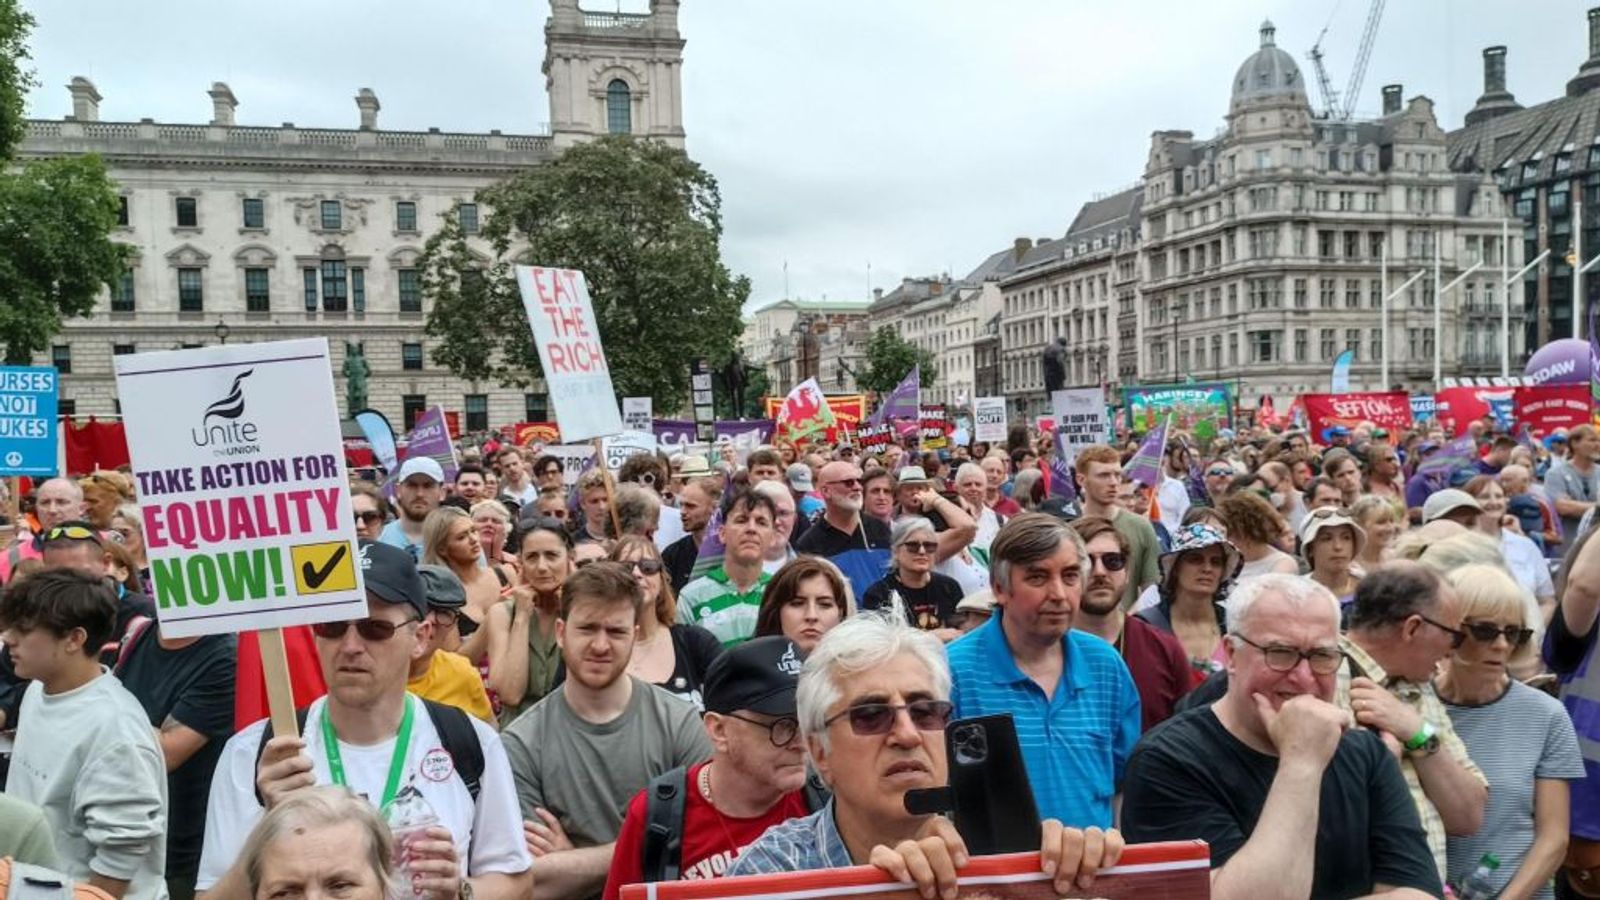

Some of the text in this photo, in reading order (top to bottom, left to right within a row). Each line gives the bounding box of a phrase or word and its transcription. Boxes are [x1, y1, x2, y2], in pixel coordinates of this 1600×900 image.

[532, 268, 579, 304] EAT
[544, 306, 589, 338] THE
[547, 341, 605, 373] RICH
[1532, 360, 1575, 384] SDAW
[1334, 399, 1392, 419] SEFTON
[136, 454, 338, 496] TAKE ACTION FOR
[142, 487, 340, 549] EQUALITY
[152, 547, 286, 609] NOW!
